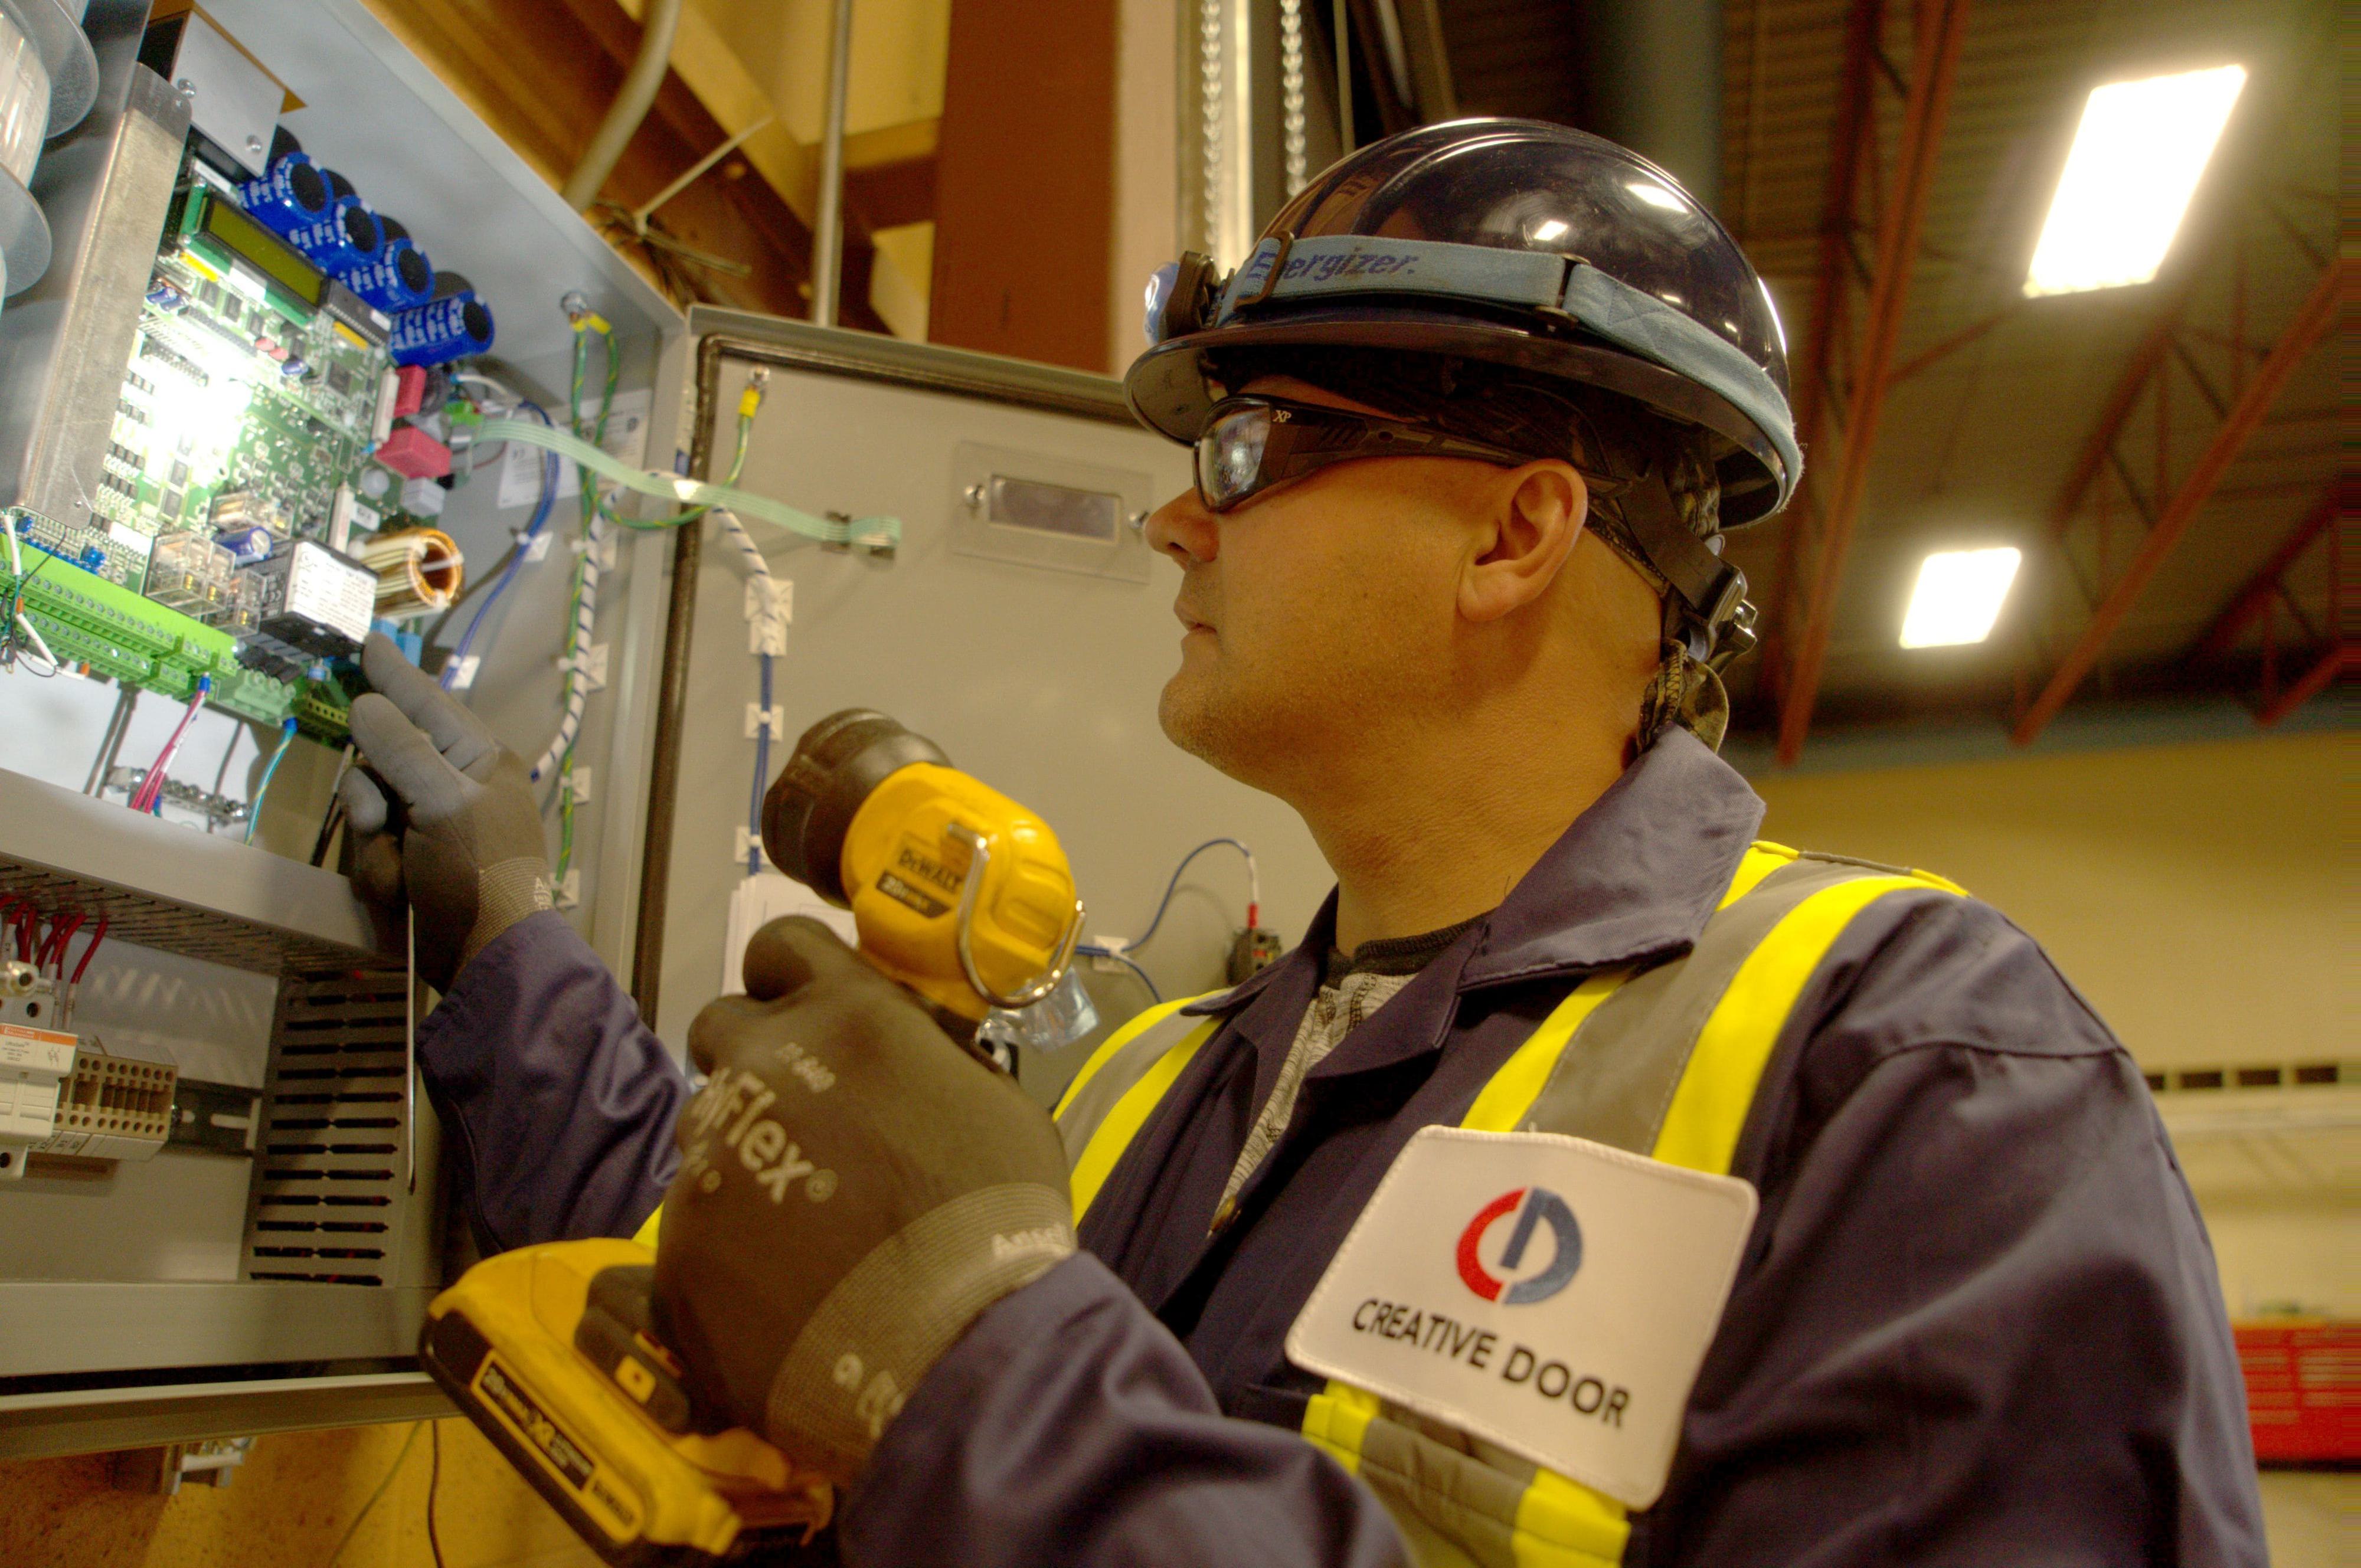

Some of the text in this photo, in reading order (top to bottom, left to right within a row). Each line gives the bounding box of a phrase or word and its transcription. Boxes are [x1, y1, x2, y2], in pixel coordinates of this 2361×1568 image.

[1273, 410, 1291, 423] XP
[1352, 1299, 1630, 1428] CREATIVE DOOR
